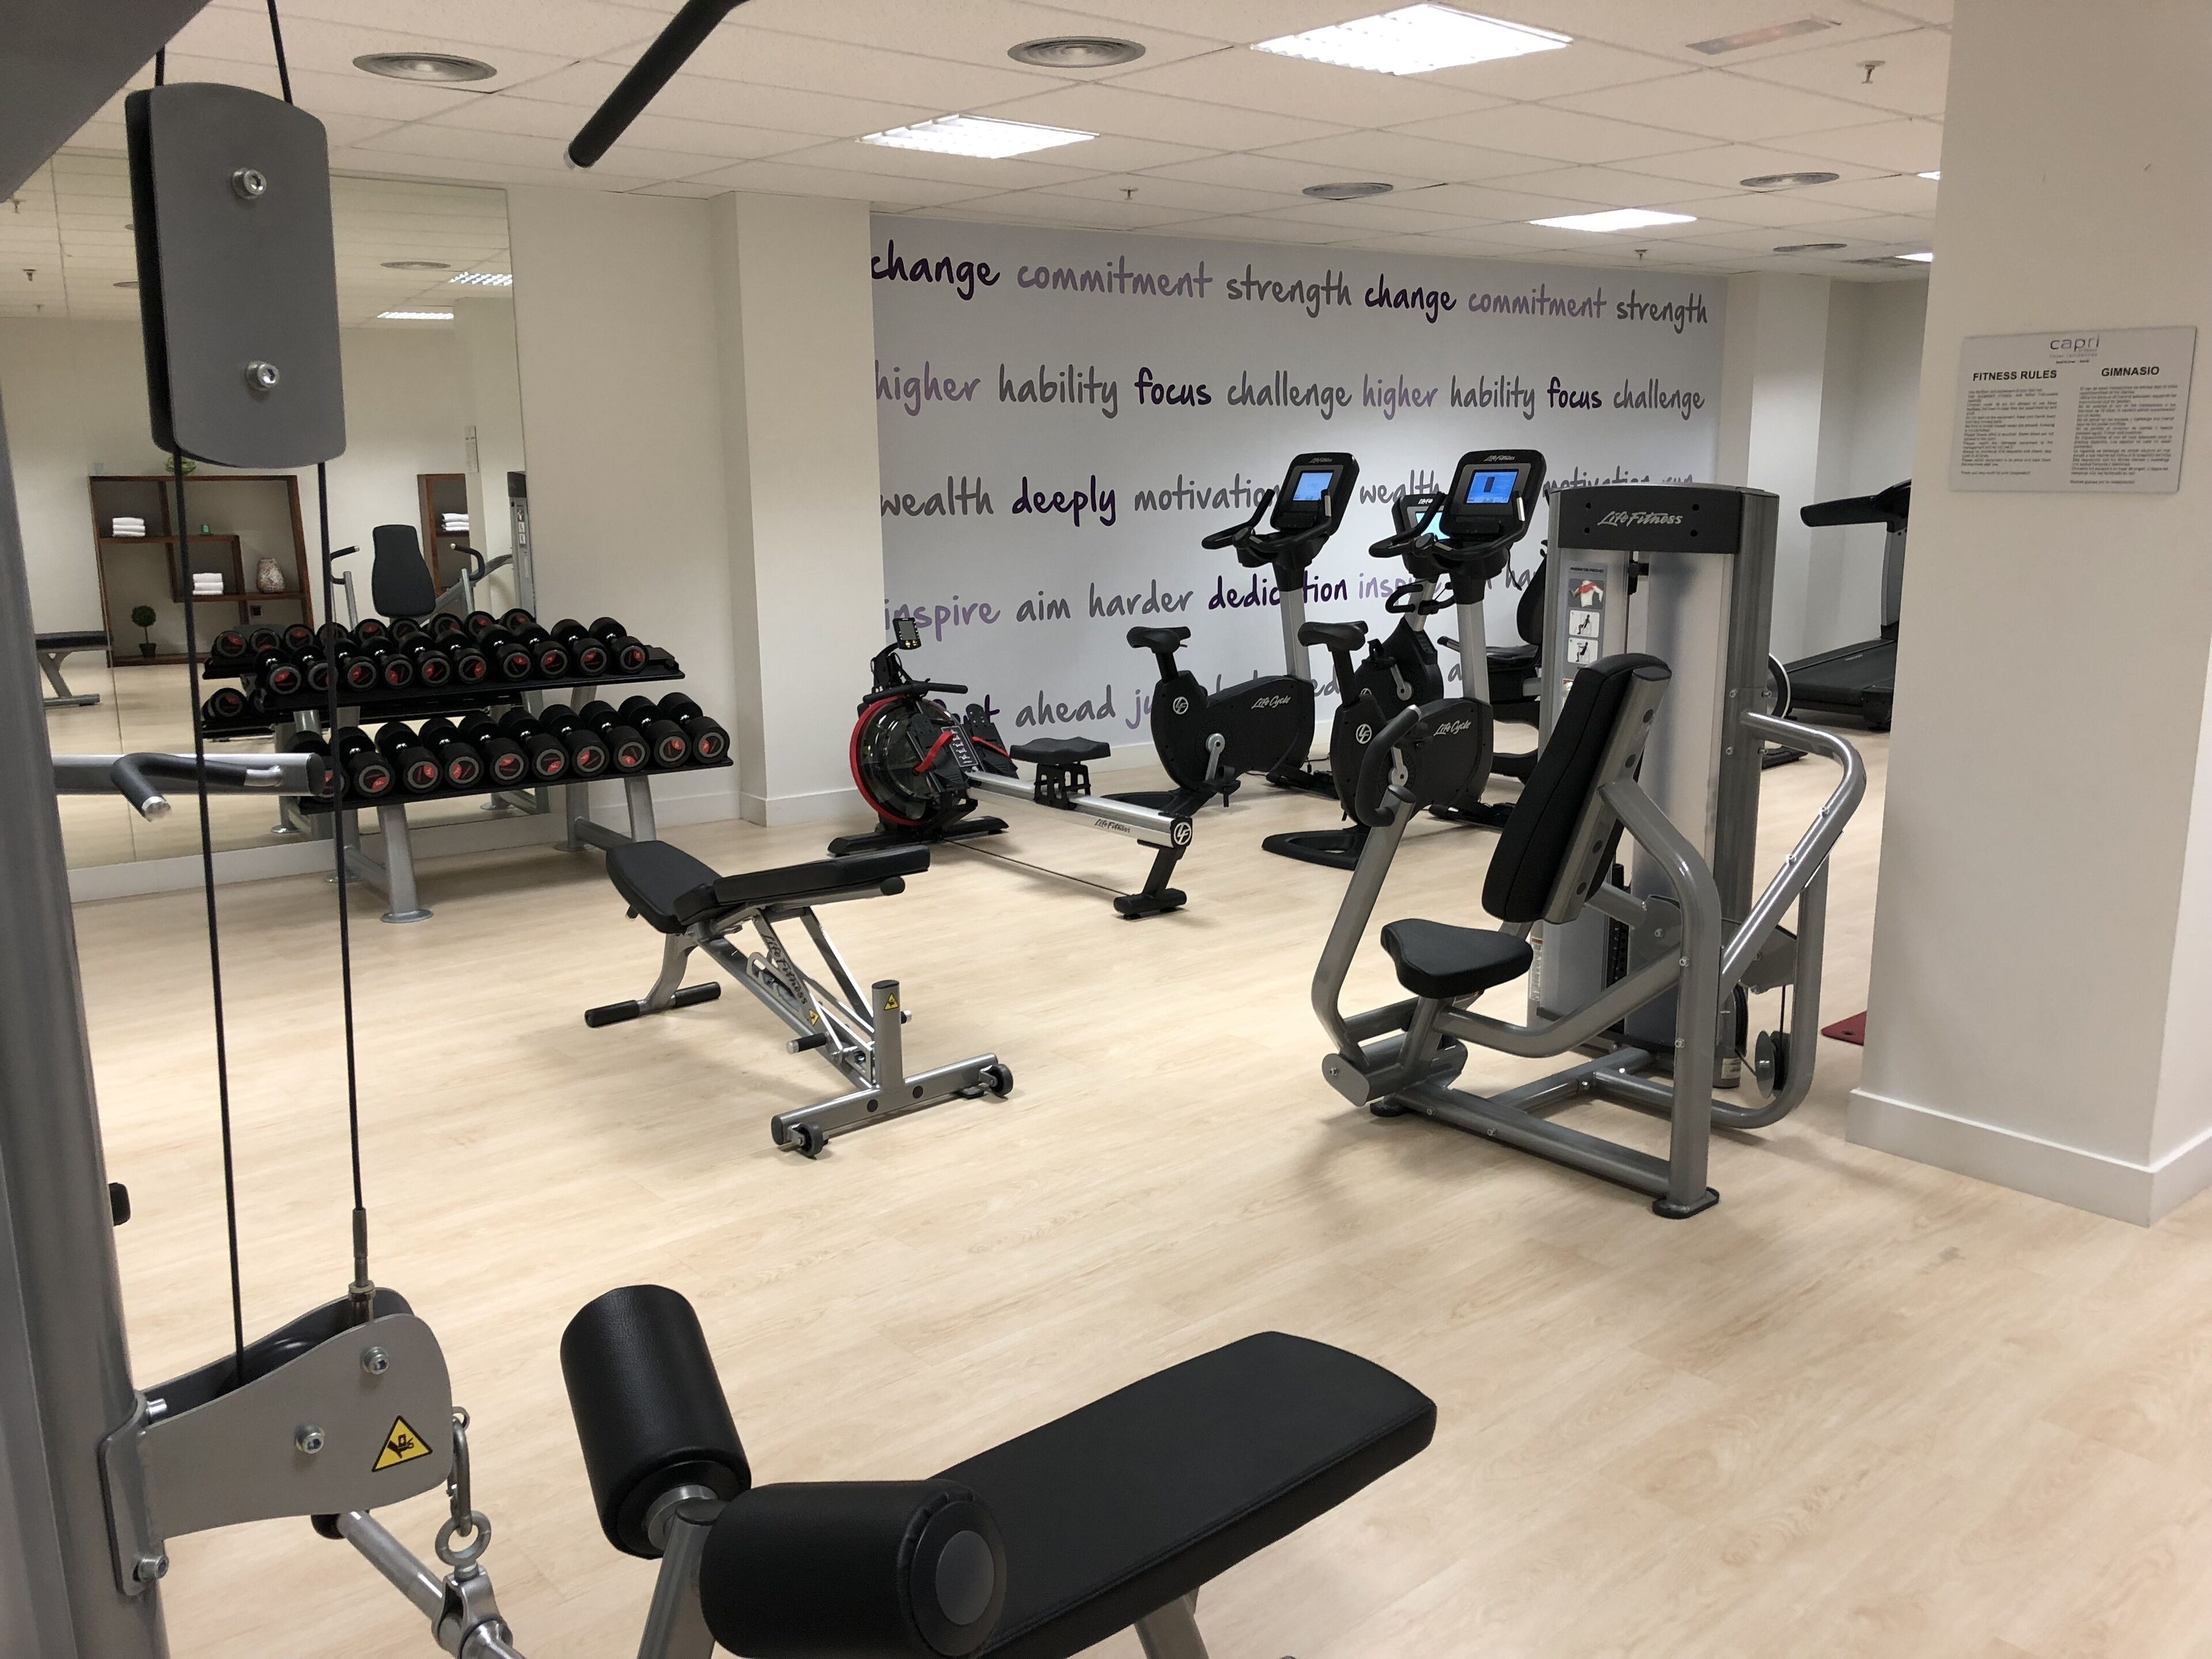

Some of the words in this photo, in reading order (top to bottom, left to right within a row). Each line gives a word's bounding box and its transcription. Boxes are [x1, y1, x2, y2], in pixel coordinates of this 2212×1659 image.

[872, 240, 1000, 300] change
[1017, 255, 1213, 298] commitment
[1226, 264, 1352, 318] strength
[1365, 274, 1456, 323] change
[1468, 283, 1607, 319] commitment
[1617, 290, 1707, 334] strength
[2050, 335, 2100, 352] capri
[875, 359, 980, 416] higher
[999, 363, 1118, 418] hability
[1134, 367, 1211, 407] focus
[1228, 370, 1352, 420] challenge
[1363, 373, 1439, 420] higher
[1450, 375, 1535, 421] hability
[1547, 377, 1603, 409] focus
[1613, 378, 1705, 421] challenge
[1973, 370, 2017, 381] FITNESS
[2020, 370, 2057, 380] RULES
[2101, 366, 2160, 377] GIMNASIO
[880, 476, 994, 517] wealth
[1012, 475, 1116, 527] deeply
[1135, 474, 1280, 511] motivatio
[885, 595, 1001, 642] inspire
[1016, 591, 1070, 622] aim
[1089, 579, 1193, 618] harder
[1209, 570, 1347, 609] dediction
[1016, 684, 1116, 728] ahead
